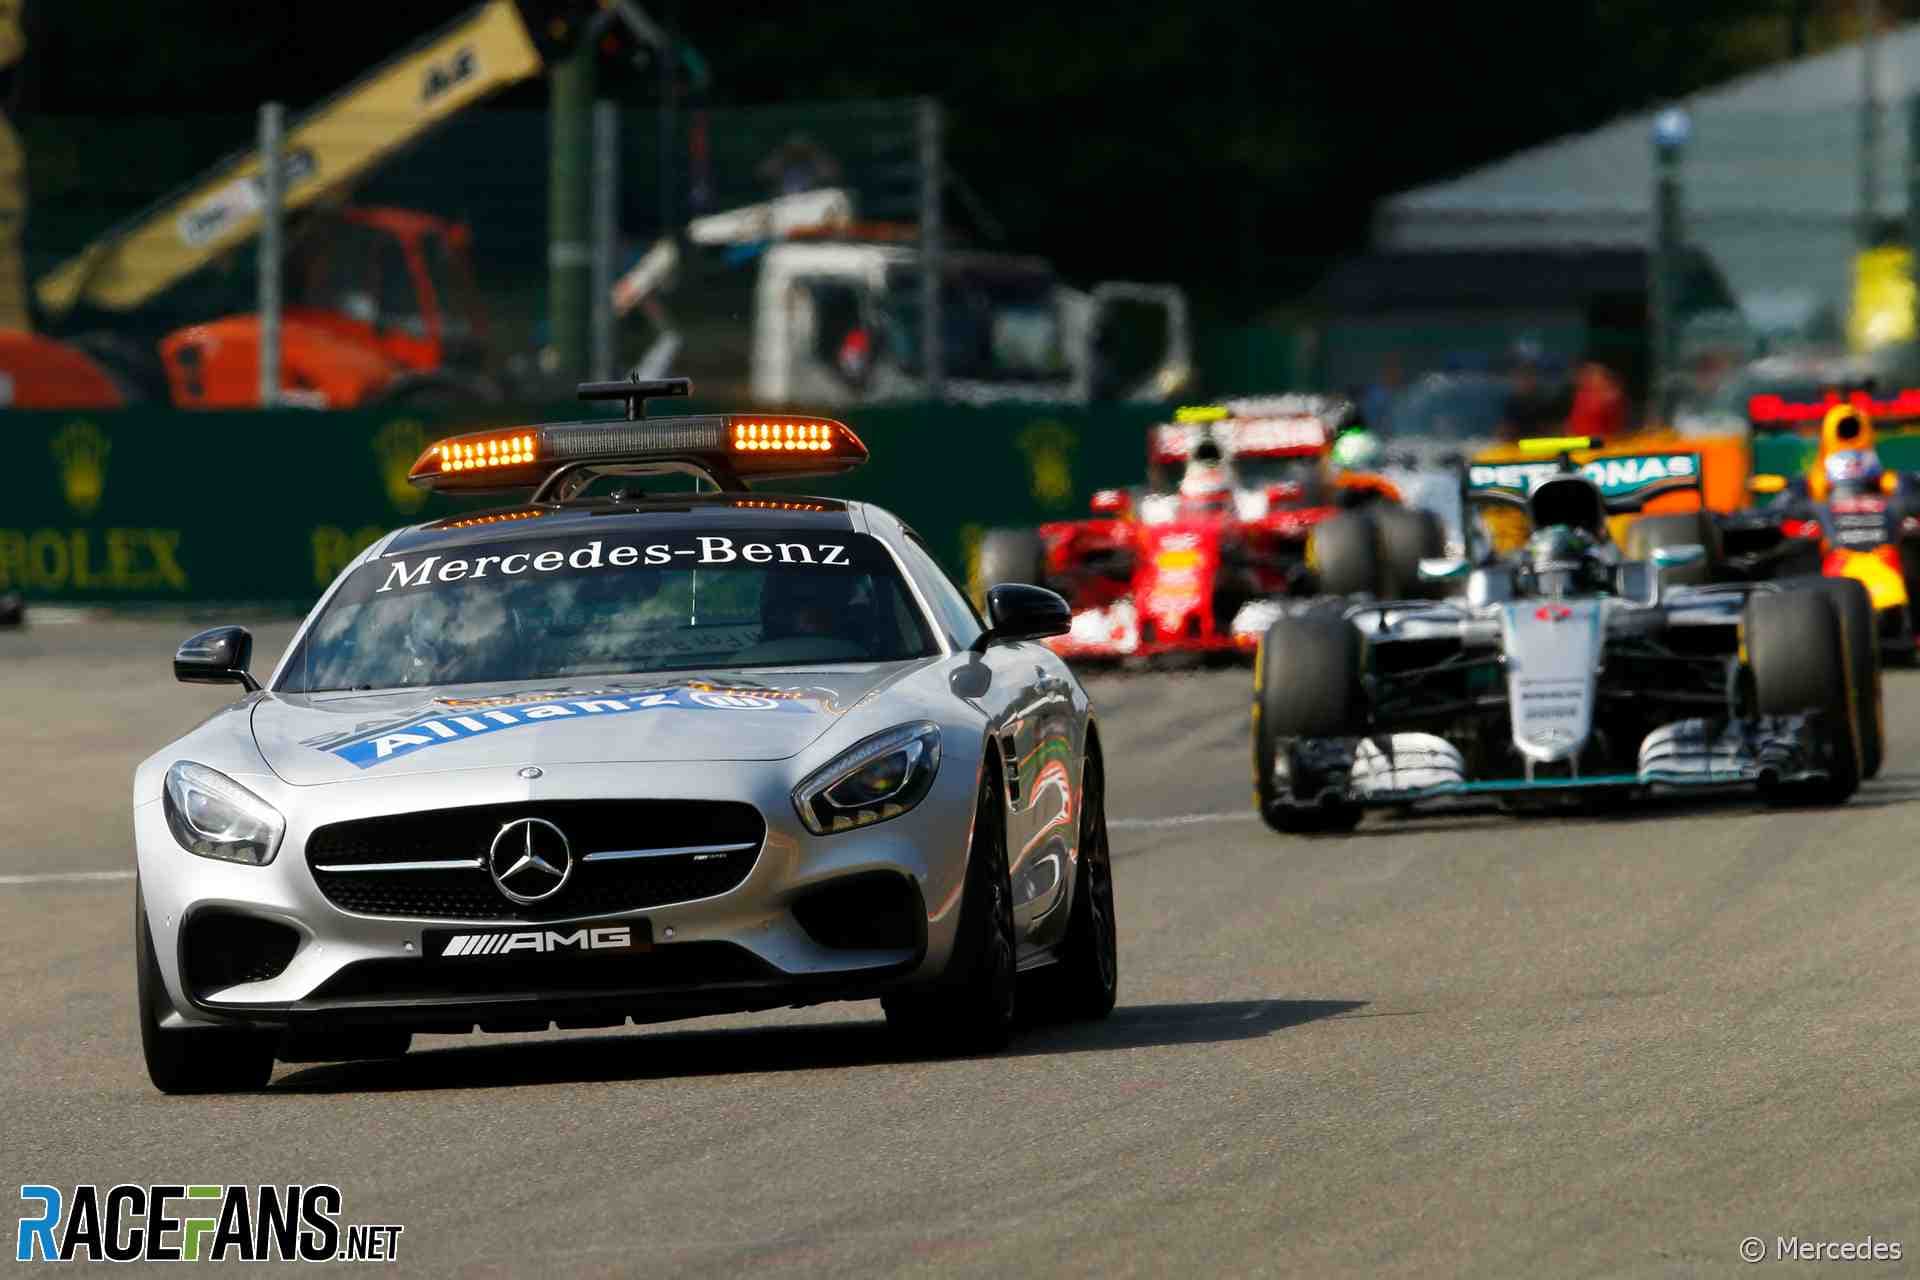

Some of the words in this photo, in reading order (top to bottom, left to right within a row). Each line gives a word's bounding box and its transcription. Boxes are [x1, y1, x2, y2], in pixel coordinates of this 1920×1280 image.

[377, 536, 850, 592] Mercedes-Benz
[369, 689, 681, 758] Allianz
[498, 927, 631, 954] AMG
